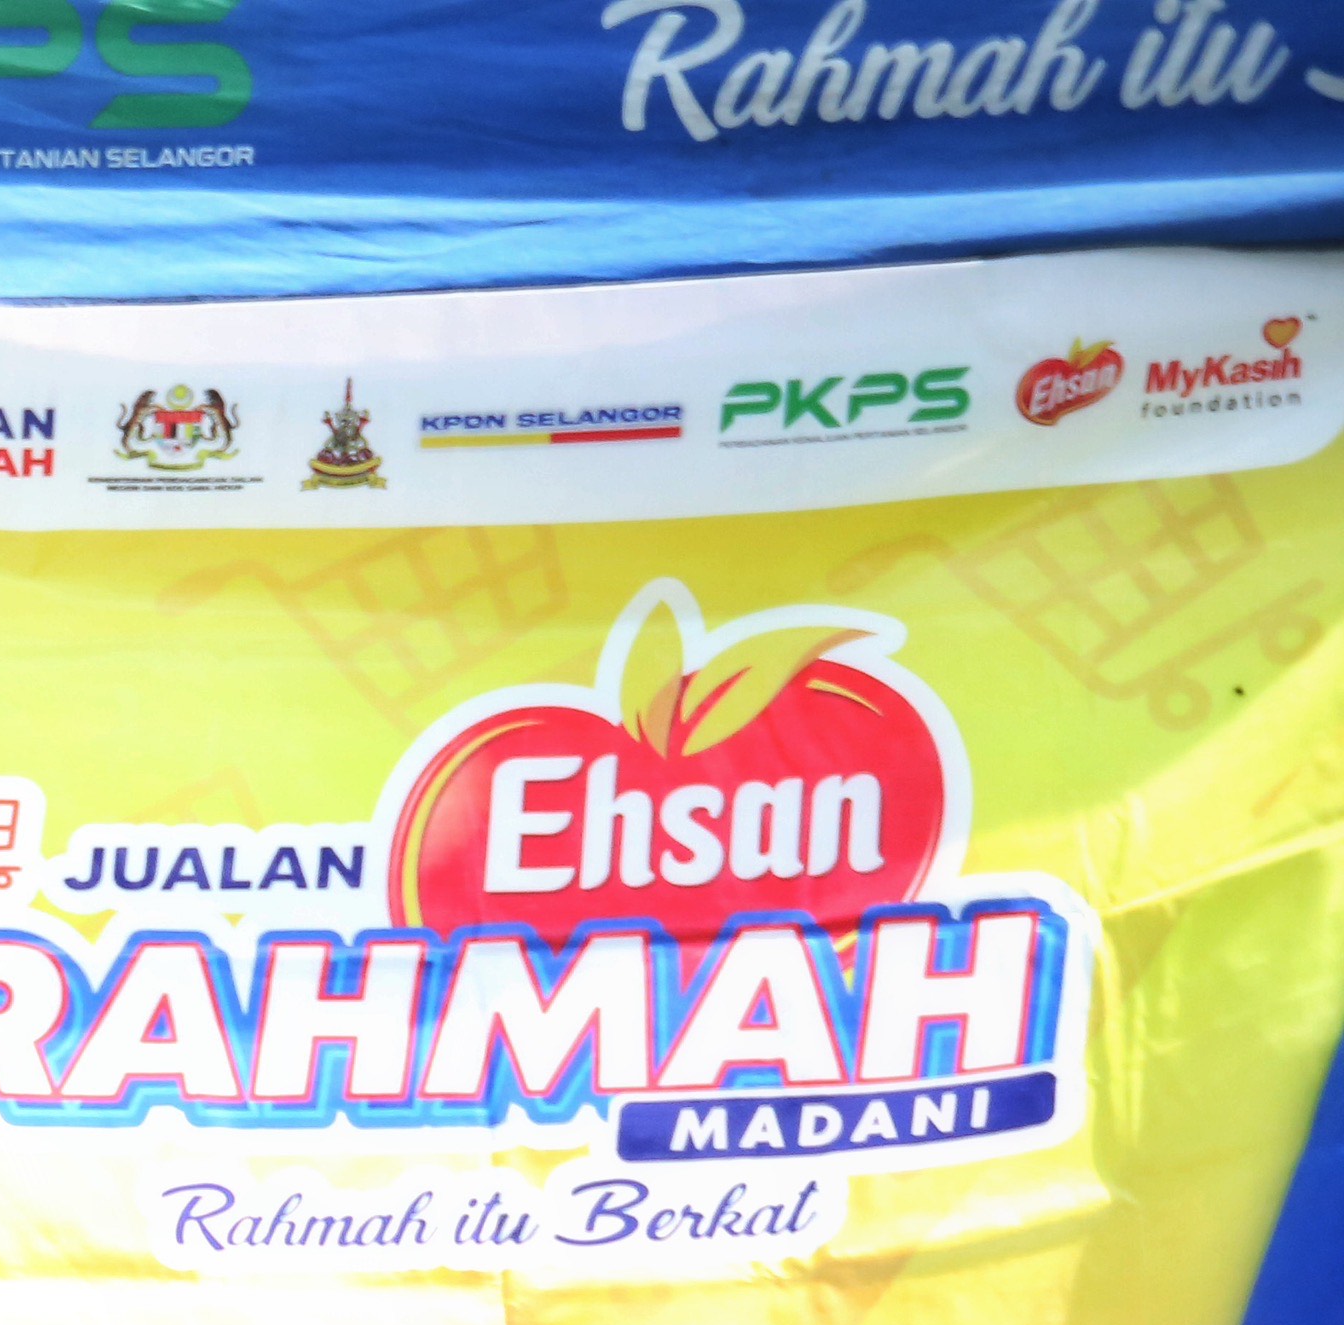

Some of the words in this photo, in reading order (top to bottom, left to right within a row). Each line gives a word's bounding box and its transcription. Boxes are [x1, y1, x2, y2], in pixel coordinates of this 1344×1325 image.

[600, 0, 1104, 141] Rahmah
[1121, 0, 1290, 110] itu
[106, 146, 255, 168] SELANGOR
[421, 412, 506, 432] KPDN
[516, 405, 682, 429] SELANGOR
[720, 366, 971, 432] PKPS
[1141, 391, 1303, 419] foundation
[483, 752, 884, 895] Ehsan
[63, 843, 366, 893] JUALAN
[669, 1087, 991, 1153] MADANI
[161, 1182, 437, 1252] Rahmah
[453, 1190, 540, 1247] itu
[555, 1179, 821, 1247] Berkat
